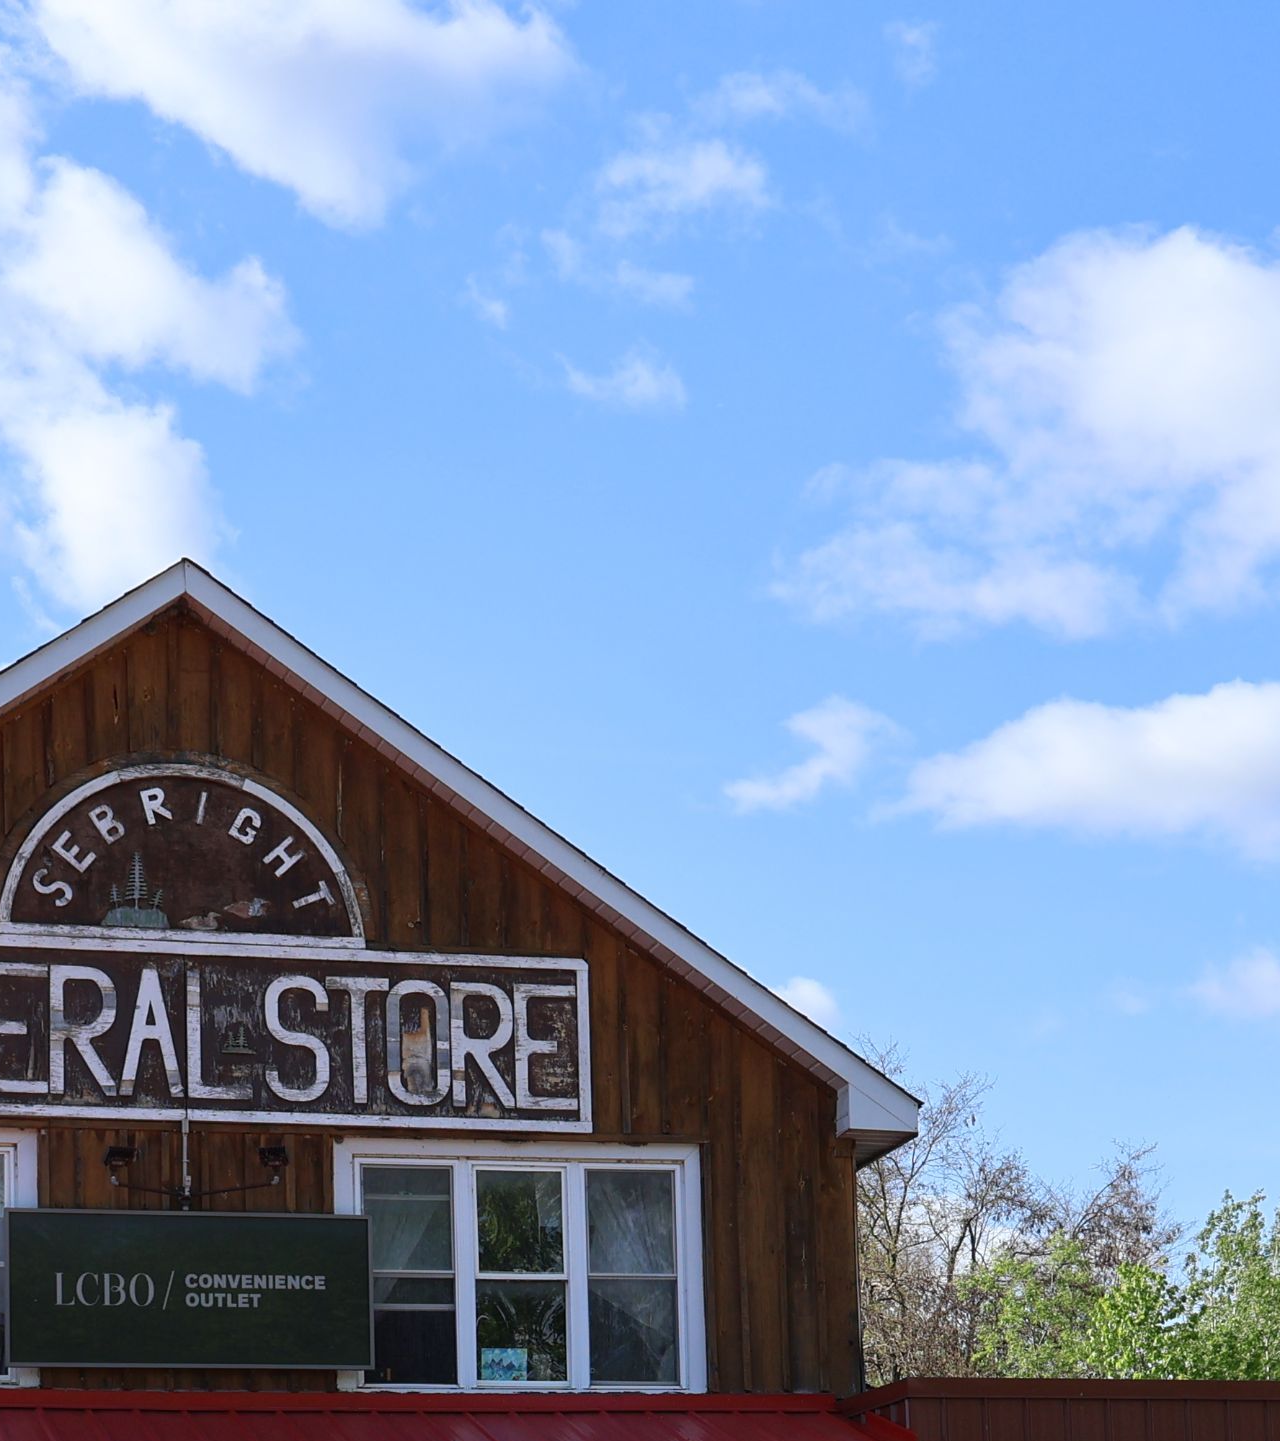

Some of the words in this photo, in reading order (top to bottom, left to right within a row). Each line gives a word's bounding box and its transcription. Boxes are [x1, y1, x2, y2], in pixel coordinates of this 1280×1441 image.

[32, 786, 337, 910] SEBRIGHT
[265, 976, 578, 1110] STORE
[185, 1274, 326, 1290] CONVENIENCE
[185, 1293, 261, 1308] OUTLET
